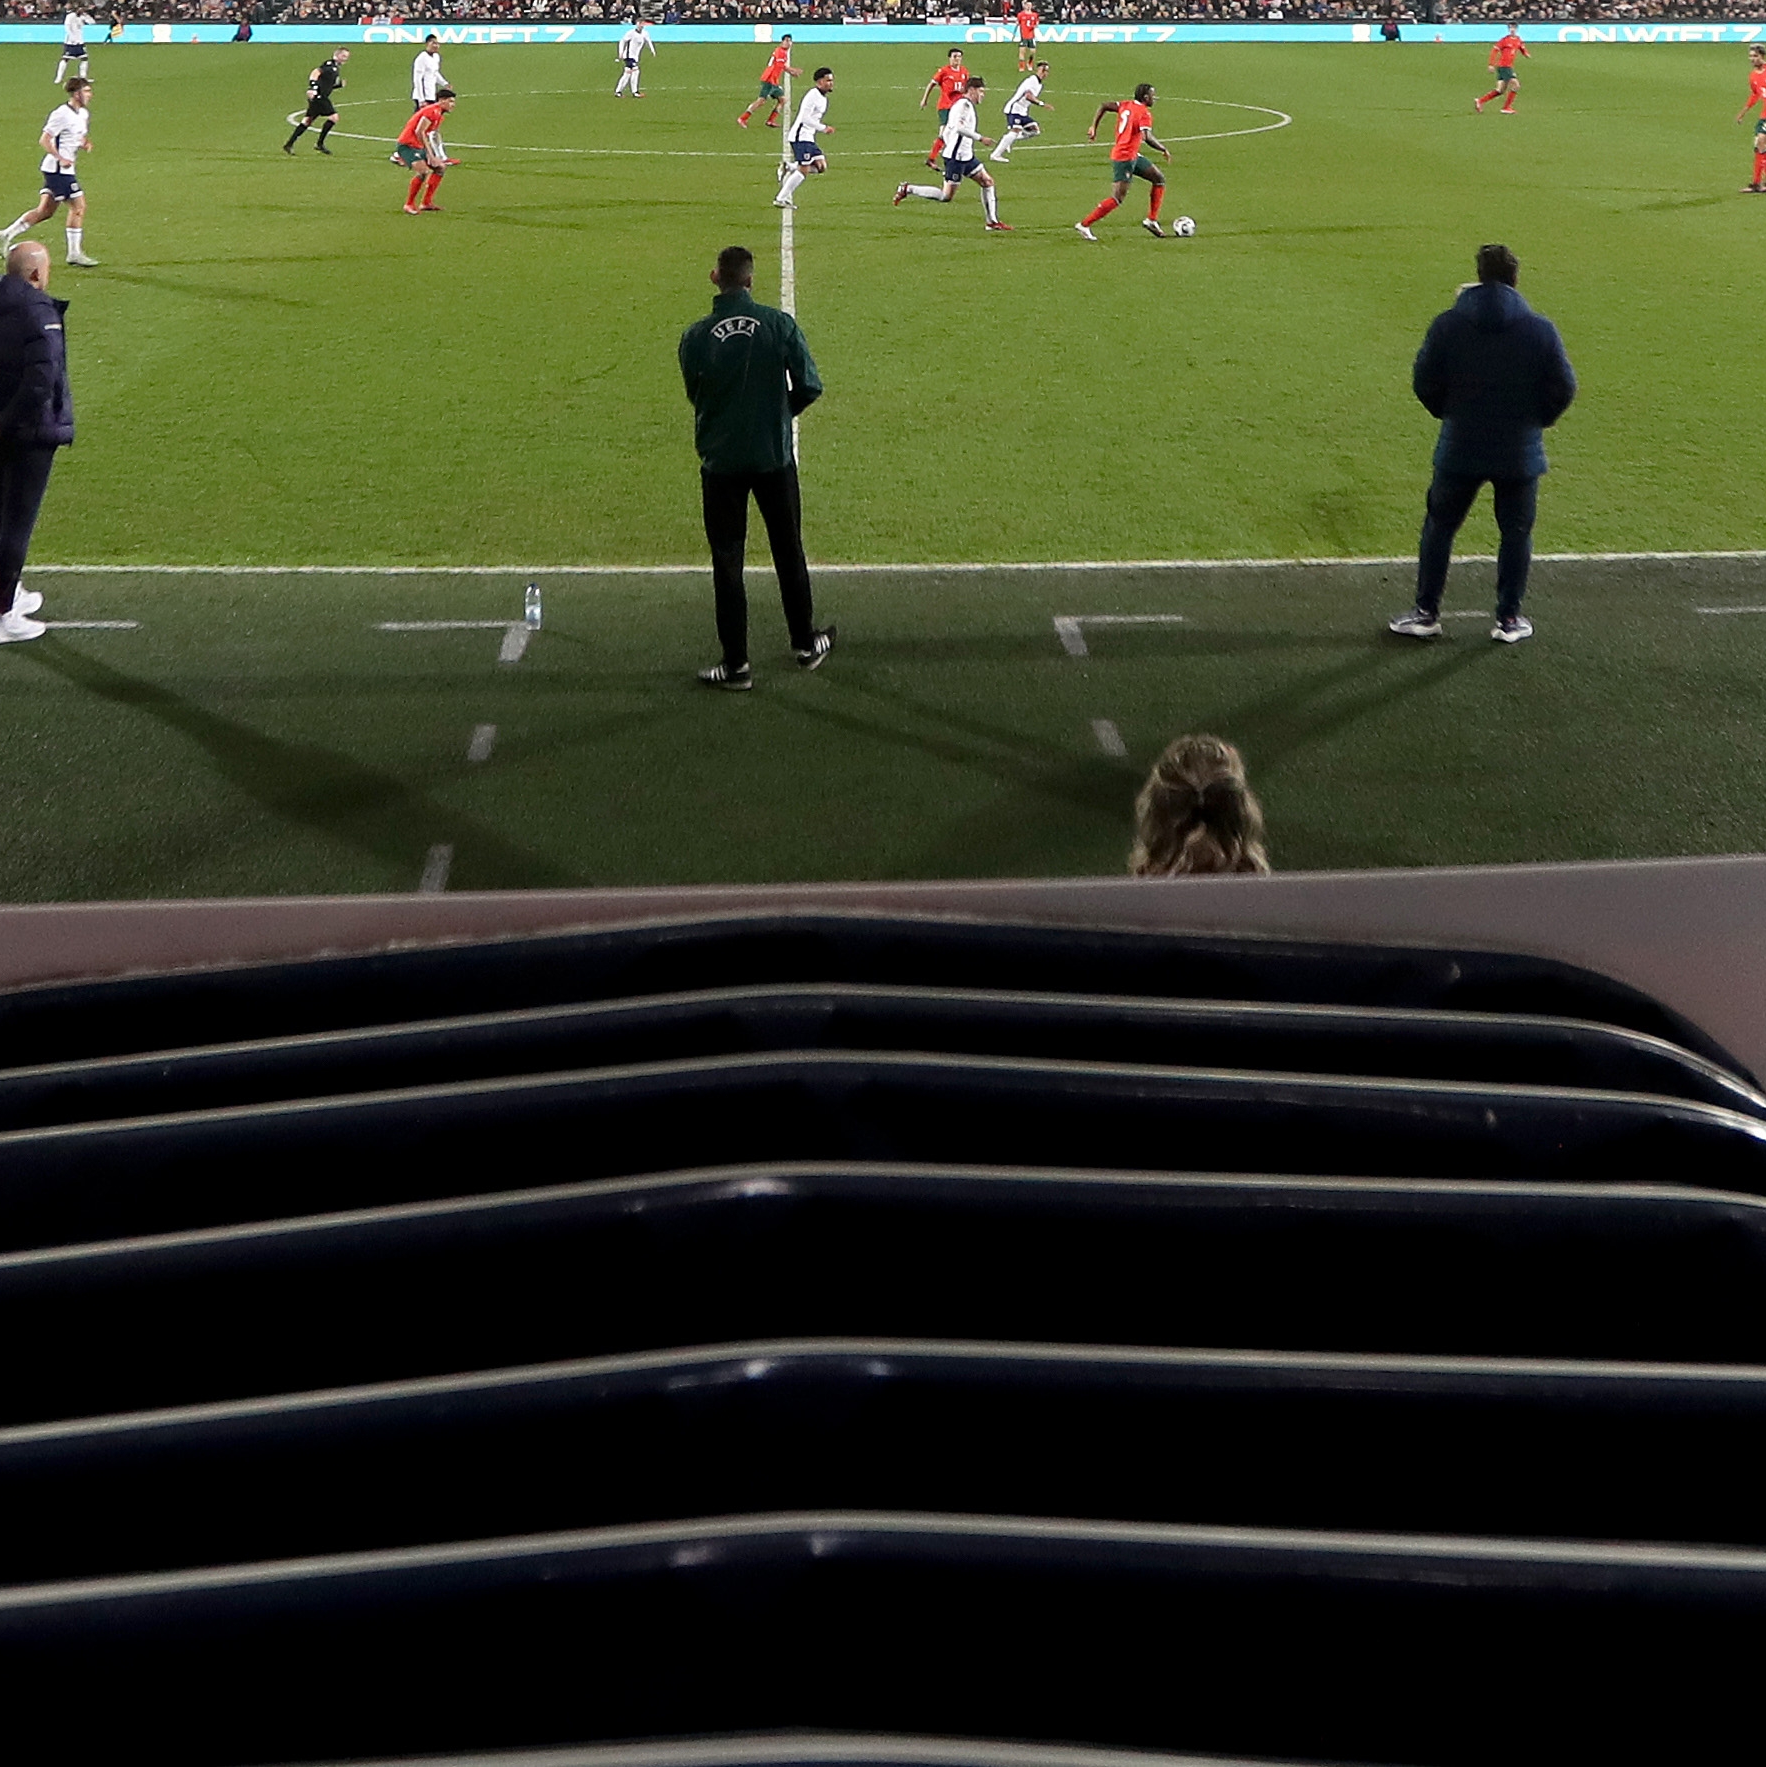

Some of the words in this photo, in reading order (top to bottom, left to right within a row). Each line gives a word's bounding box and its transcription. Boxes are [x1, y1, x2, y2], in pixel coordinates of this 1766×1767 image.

[363, 26, 431, 44] ON
[544, 26, 577, 43] 7
[1144, 26, 1177, 43] 7
[1558, 26, 1617, 43] ON
[1732, 26, 1763, 43] 7
[713, 319, 757, 339] UEFA
